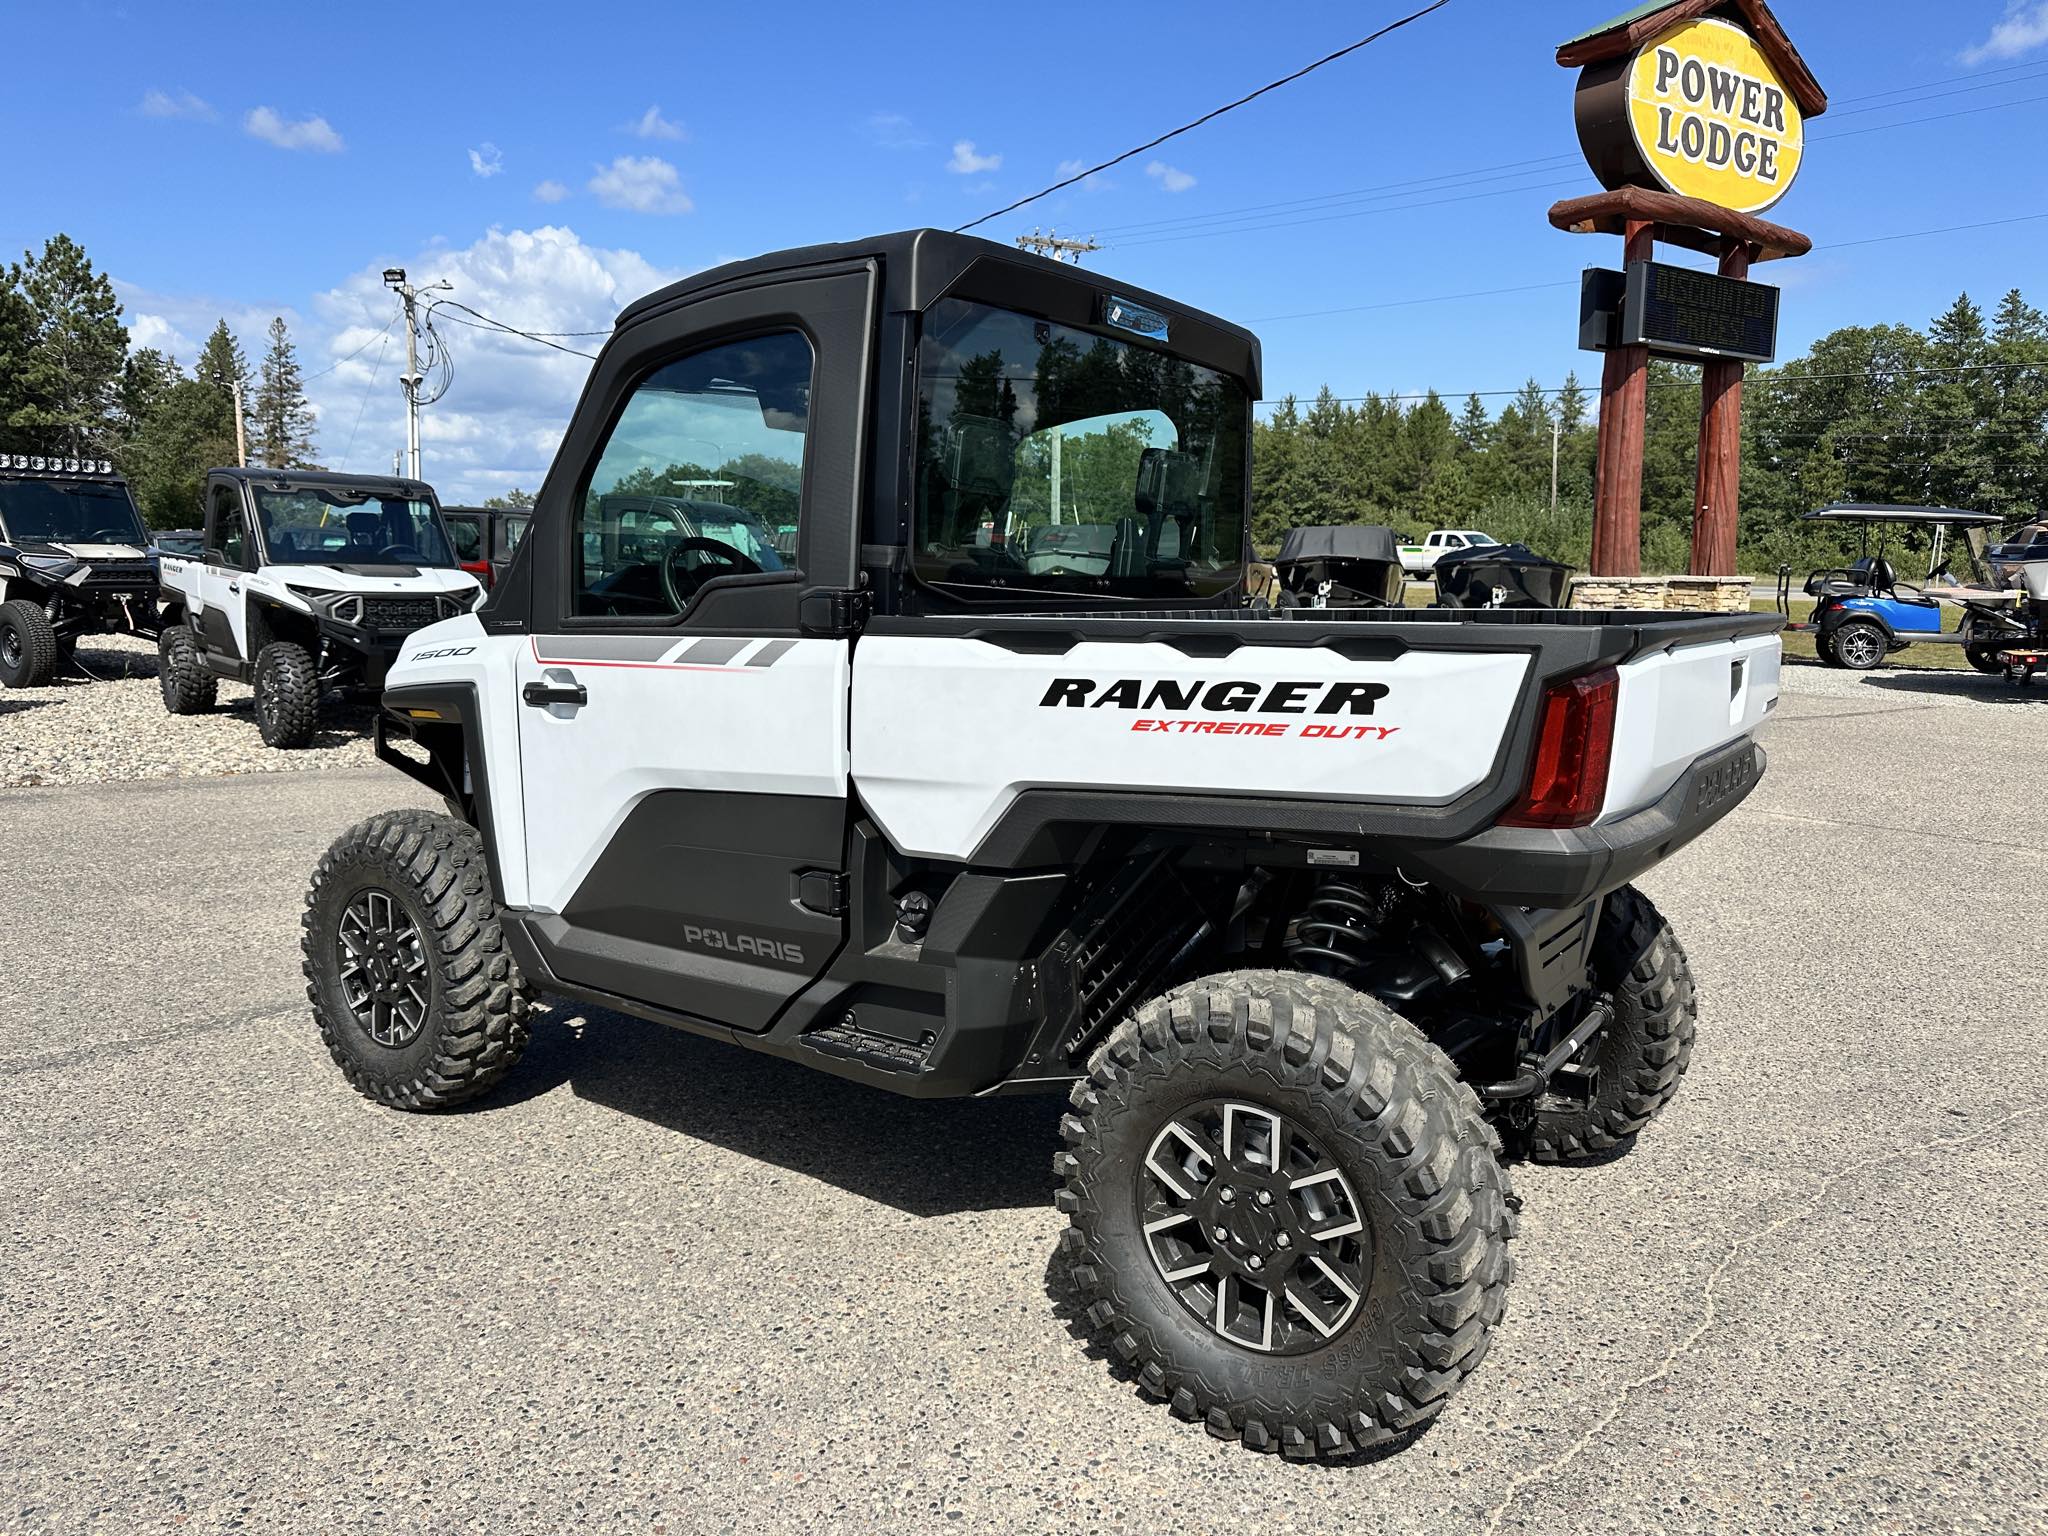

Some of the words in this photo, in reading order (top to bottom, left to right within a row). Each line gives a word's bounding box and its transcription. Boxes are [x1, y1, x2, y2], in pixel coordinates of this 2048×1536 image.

[1655, 48, 1785, 133] POWER
[1656, 106, 1779, 182] LODGE
[1655, 267, 1766, 319] DISCOUNTED
[366, 605, 433, 616] POLARIS
[410, 646, 478, 662] 1500
[1039, 677, 1390, 716] RANGER
[1130, 719, 1290, 737] EXTREME
[1298, 723, 1401, 741] DUTY
[683, 924, 805, 964] POLARIS
[1322, 1298, 1384, 1380] CROSS
[1232, 1361, 1311, 1389] TRAI
